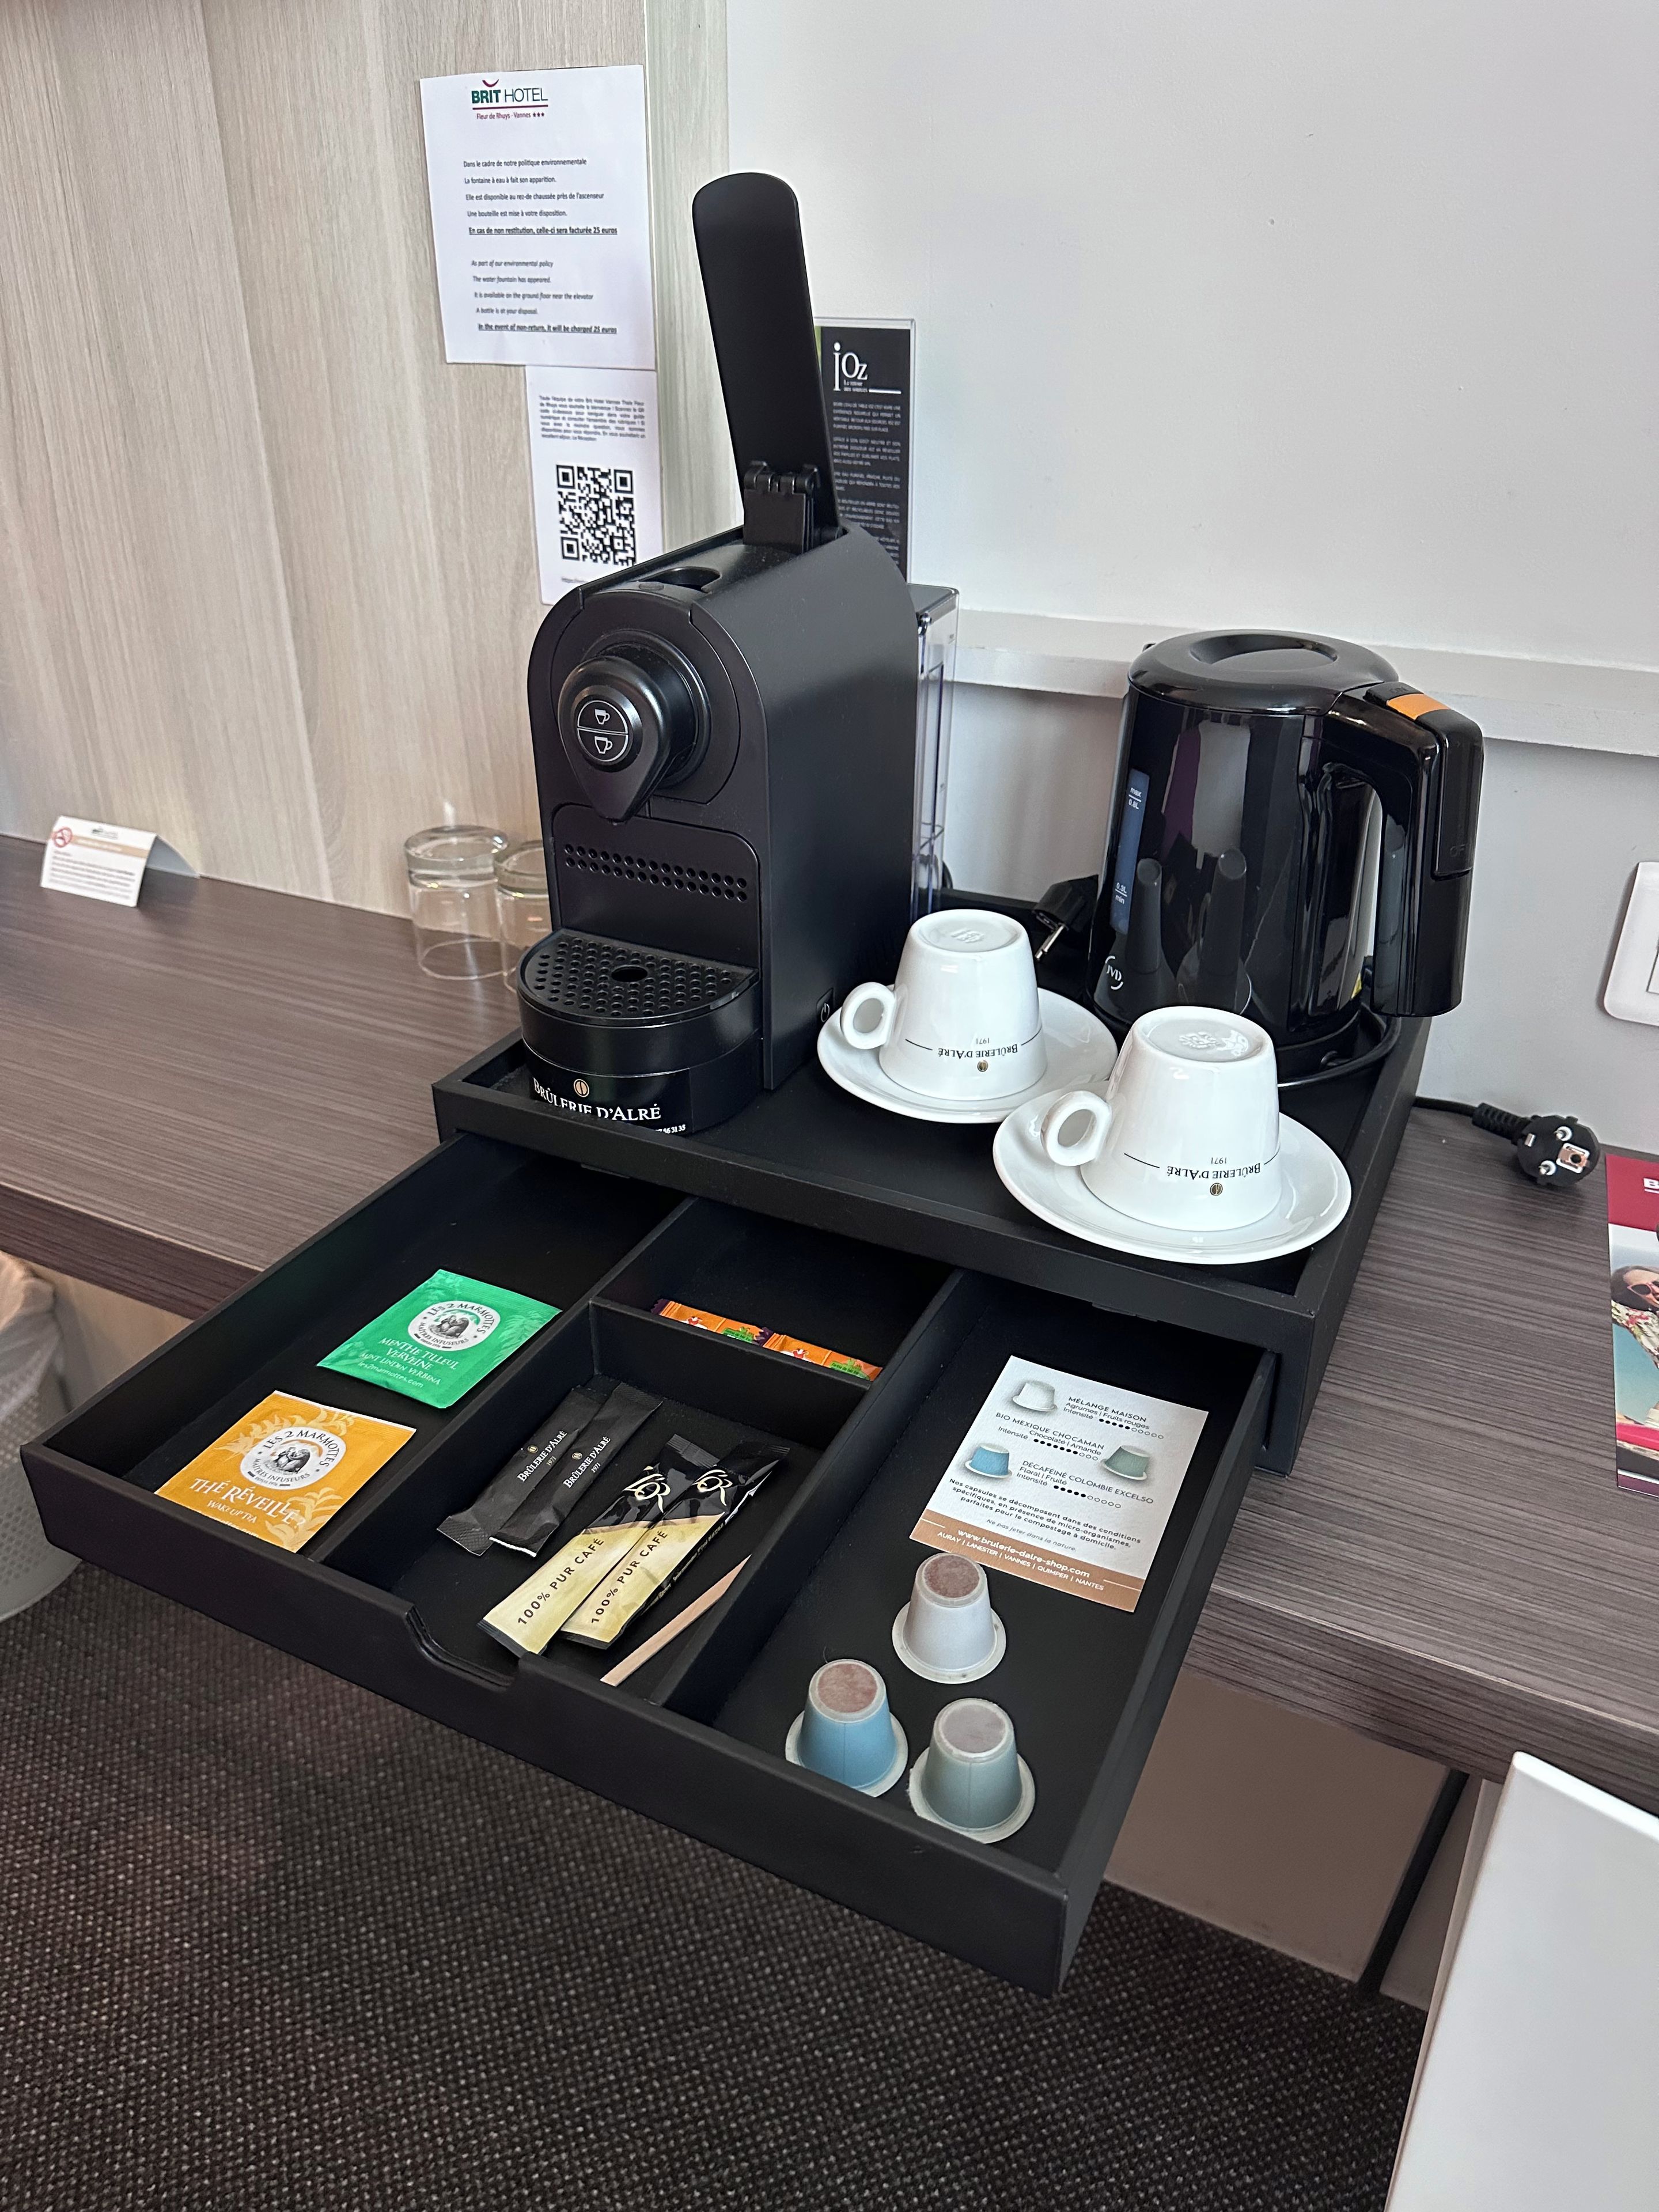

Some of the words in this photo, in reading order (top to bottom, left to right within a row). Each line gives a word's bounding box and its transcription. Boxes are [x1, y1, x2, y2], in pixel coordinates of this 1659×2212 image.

[471, 89, 501, 104] BRIT
[505, 88, 548, 103] HOTEL
[518, 159, 540, 168] politique
[540, 158, 587, 166] environnementale
[529, 176, 556, 184] apparition.
[536, 226, 556, 234] celle-ci
[569, 226, 593, 234] facturée
[1130, 787, 1142, 797] max
[1128, 798, 1139, 810] 0.8L
[1116, 882, 1127, 893] 0.3L
[1115, 895, 1125, 904] min
[938, 1048, 973, 1059] D'ALRÉ
[976, 1044, 1018, 1058] BRÛLERIE
[533, 1077, 592, 1114] BRÛLERIE
[596, 1103, 661, 1121] D'ALRÉ
[1166, 1166, 1209, 1180] D'ALRÉ
[1212, 1162, 1260, 1179] BRÛLERIE
[427, 1306, 446, 1316] LES
[458, 1303, 495, 1334] MARMOTTES
[432, 1337, 469, 1346] INFUSEURS
[378, 1337, 422, 1355] MENTHE
[421, 1350, 460, 1370] TILLEUL
[386, 1347, 433, 1370] VERVEINE
[408, 1368, 441, 1386] VERBENA
[1063, 1407, 1096, 1419] Intensité
[1065, 1402, 1098, 1415] Agrumes
[1103, 1412, 1123, 1422] Fruits
[1124, 1419, 1149, 1430] rouges
[1068, 1396, 1109, 1412] MÉLANGE
[1111, 1409, 1147, 1423] MAISON
[995, 1412, 1010, 1421] BIO
[1012, 1418, 1050, 1434] MEXIQUE
[1052, 1430, 1104, 1450] CHOCAMAN
[998, 1426, 1028, 1440] Intensité
[263, 1436, 283, 1449] LES
[296, 1430, 339, 1467] MARMOTTES
[1029, 1430, 1066, 1445] Chocolaté
[1070, 1443, 1101, 1456] Amande
[517, 1450, 548, 1482] BRÛLERIE
[545, 1430, 567, 1453] D'ALRÉ
[546, 1456, 556, 1466] 1971
[563, 1456, 593, 1488] BRÛLERIE
[590, 1436, 611, 1459] D'ALRÉ
[268, 1472, 310, 1483] INFUSEURS
[591, 1462, 601, 1473] 1971
[1019, 1466, 1041, 1478] Floral
[1045, 1475, 1067, 1486] Fruité
[1016, 1472, 1048, 1486] Intensité
[1022, 1460, 1067, 1479] DÉCAFÉINÉ
[1069, 1475, 1113, 1493] COLOMBIE
[1114, 1488, 1154, 1504] EXCELSO
[189, 1478, 231, 1494] THÉ
[221, 1486, 299, 1524] RÉVEILLE
[949, 1478, 964, 1487] Nos
[964, 1484, 997, 1498] capsules
[1009, 1499, 1060, 1519] décomposent
[1062, 1516, 1081, 1525] dans
[1099, 1528, 1141, 1543] conditions
[207, 1500, 230, 1513] WAKE
[242, 1511, 257, 1524] TEA
[952, 1487, 995, 1505] spécifiques,
[1009, 1506, 1044, 1520] présence
[1058, 1522, 1131, 1548] micro-organismes,
[960, 1497, 995, 1510] parfaites
[994, 1509, 1013, 1517] pour
[1024, 1518, 1071, 1536] compostage
[1080, 1536, 1116, 1550] domicile.
[1009, 1527, 1026, 1535] jeter
[1027, 1533, 1043, 1541] dans
[1052, 1541, 1076, 1551] nature.
[937, 1532, 961, 1543] AURAY
[966, 1541, 998, 1556] LANESTER
[1004, 1554, 1031, 1567] VANNES
[1037, 1566, 1069, 1580] QUIMPER
[1075, 1577, 1104, 1590] NANTES
[518, 1592, 551, 1624] 100%
[550, 1566, 575, 1590] PUR
[574, 1538, 604, 1565] CAFÉ
[591, 1588, 619, 1624] 100%
[617, 1560, 640, 1584] PUR
[639, 1531, 668, 1557] CAFÉ
